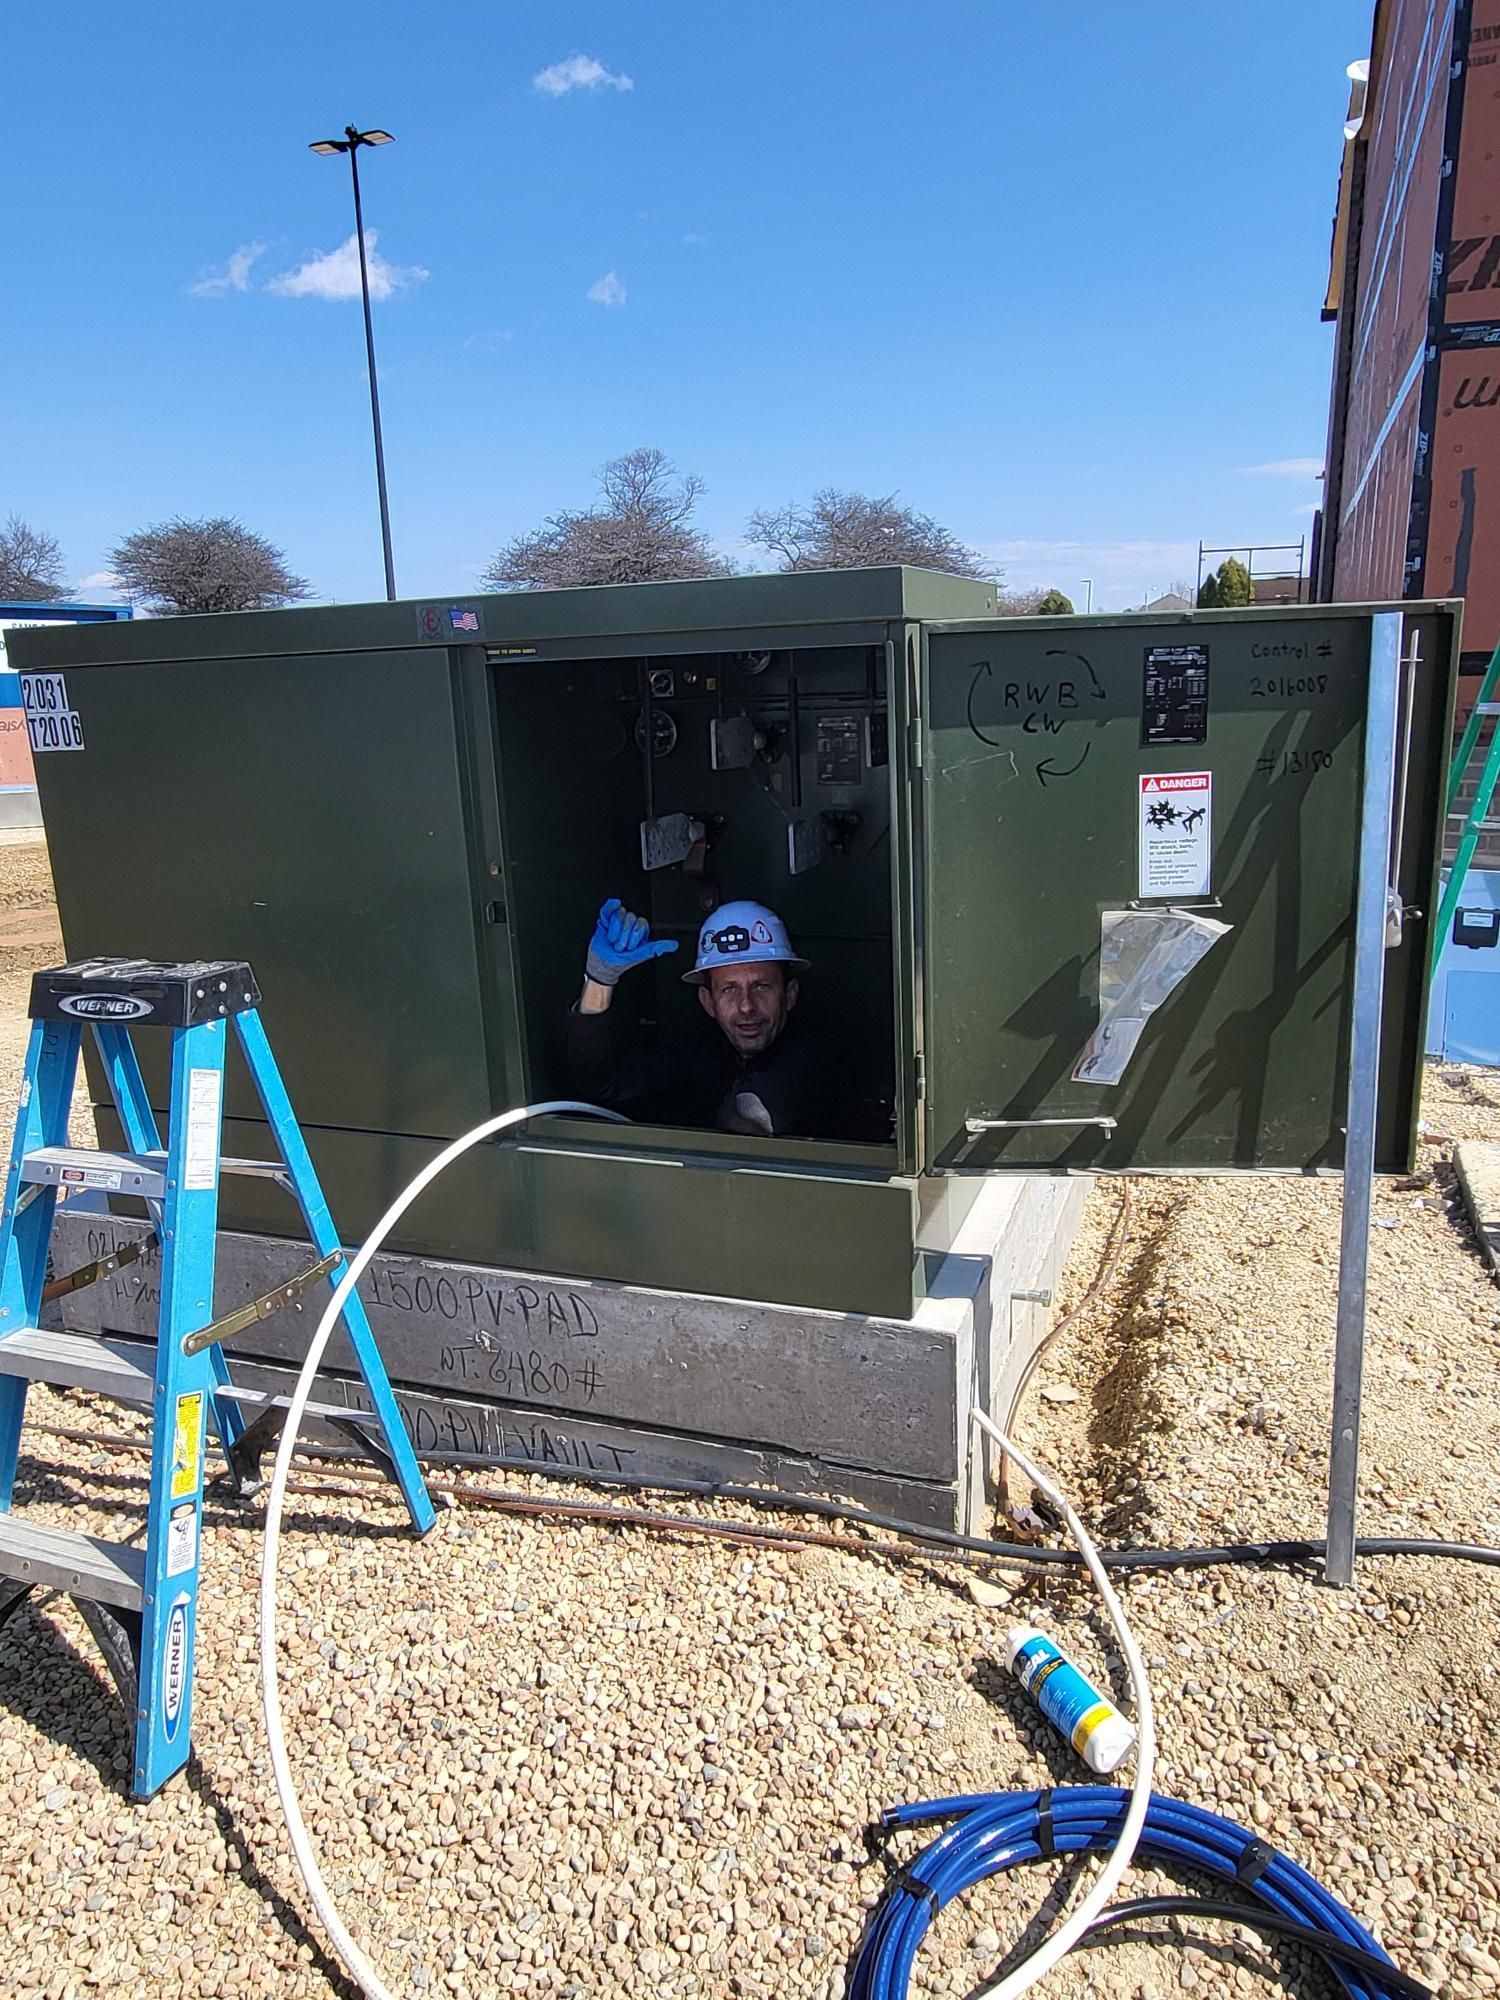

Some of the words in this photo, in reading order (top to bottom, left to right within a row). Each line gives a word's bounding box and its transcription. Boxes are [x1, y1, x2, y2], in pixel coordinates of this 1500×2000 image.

[1251, 640, 1309, 659] Control
[1315, 639, 1334, 660] #
[22, 678, 67, 710] 2031
[28, 714, 83, 749] T2006
[1022, 711, 1066, 735] CW
[1159, 777, 1207, 789] DANGER
[75, 1000, 135, 1013] WERNER
[168, 1619, 183, 1710] WERNER
[1020, 1648, 1051, 1692] IDEAL
